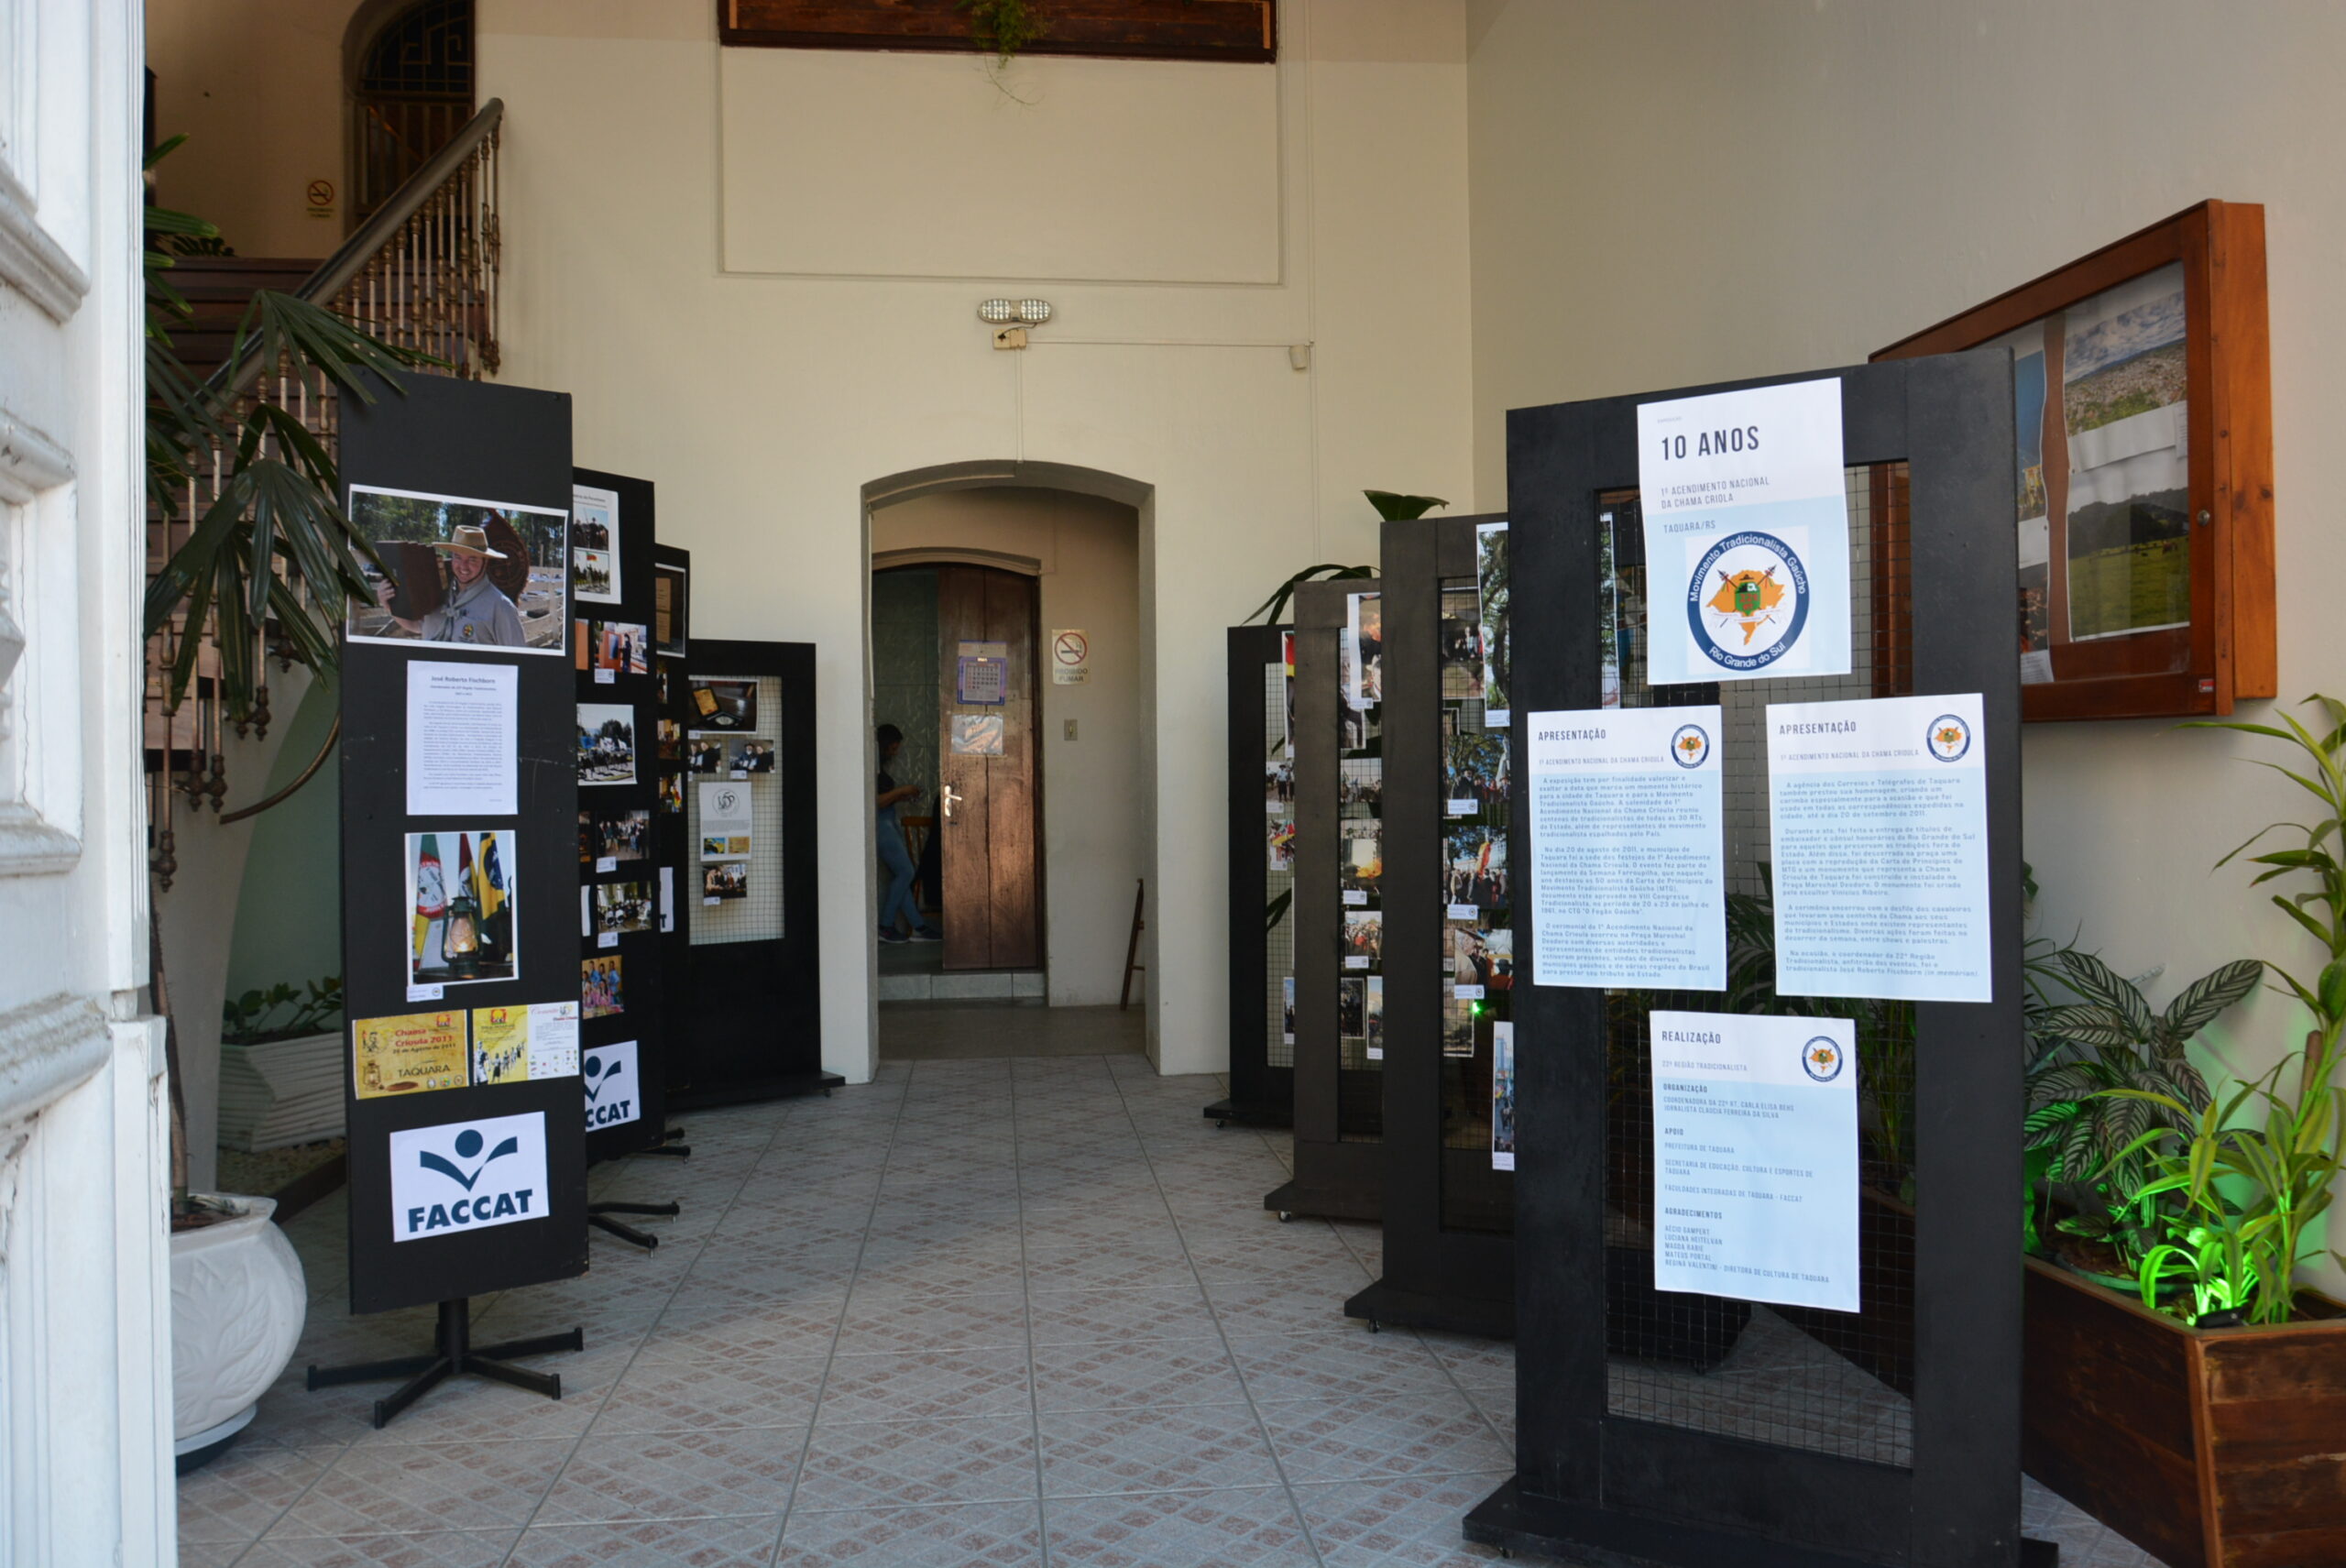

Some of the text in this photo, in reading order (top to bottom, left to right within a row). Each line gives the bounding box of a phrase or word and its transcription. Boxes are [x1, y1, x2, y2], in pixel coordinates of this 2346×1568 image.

[1661, 426, 1760, 460] 10 ANOS
[1672, 480, 1727, 496] ACENDIMENTO
[1729, 476, 1770, 489] NACIONAL
[1661, 493, 1734, 510] DA CHAMA CRIOLA
[1663, 520, 1716, 533] TAQUARA/RS
[1689, 533, 1806, 602] Movimento Tradicionalista Gaúcho
[1708, 641, 1786, 668] Rio Grande do Sul
[1538, 729, 1606, 741] APRESENTAÇÃO
[1779, 721, 1857, 736] APRESENTAÇÃO
[1661, 1030, 1721, 1045] REALIZAÇÃO
[398, 1064, 451, 1078] TAQUARA
[1662, 1083, 1708, 1093] ORGANIZAÇÃO
[586, 1100, 630, 1128] CCAT
[1664, 1126, 1684, 1135] APOIO
[408, 1189, 533, 1234] FACCAT
[1664, 1207, 1723, 1220] AGRADECIMENTOS
